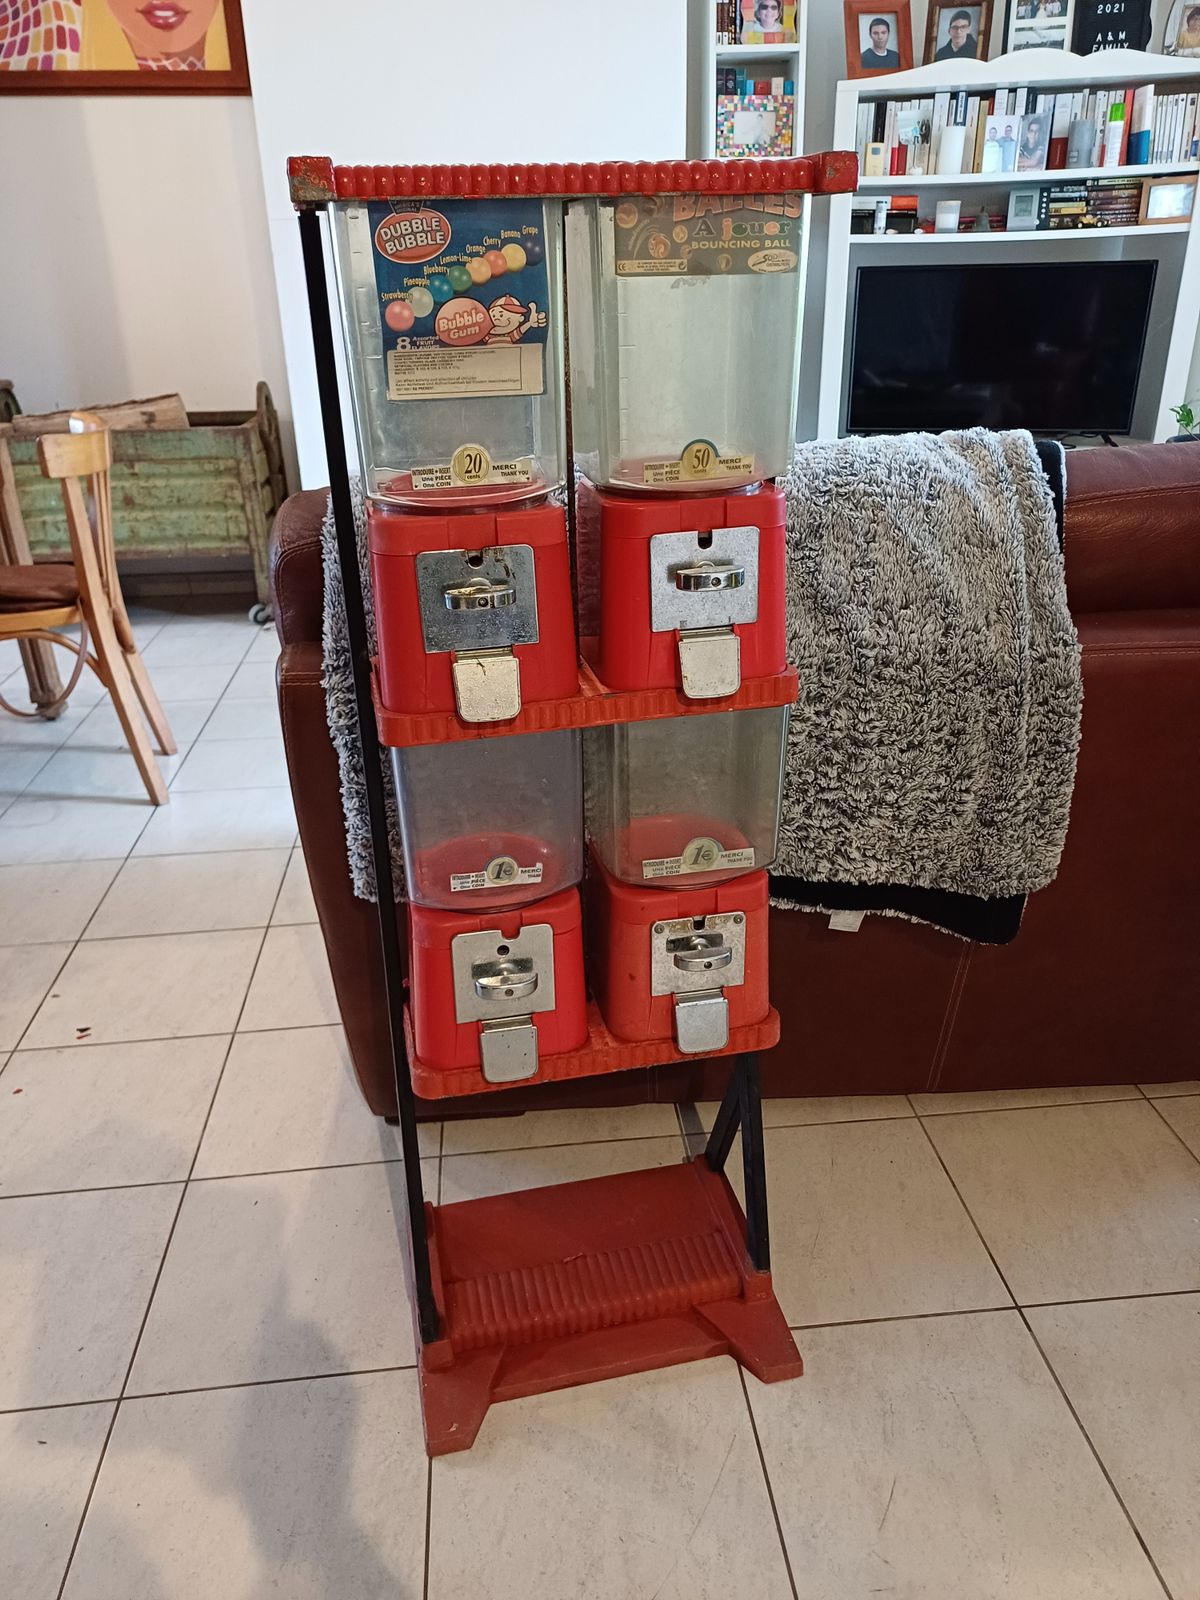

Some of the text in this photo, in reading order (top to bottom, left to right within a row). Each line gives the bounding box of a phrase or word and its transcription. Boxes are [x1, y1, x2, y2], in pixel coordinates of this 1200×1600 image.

[1097, 3, 1126, 14] 2021
[1096, 30, 1126, 42] A & M
[1092, 42, 1129, 52] FAMILY
[673, 194, 802, 222] BALLES
[380, 217, 441, 241] DUBBLE
[501, 230, 521, 239] Banana
[522, 225, 539, 235] Grape
[693, 218, 792, 241] A jouer
[385, 231, 446, 255] BUBBLE
[483, 236, 502, 247] Cherry
[691, 238, 792, 249] BOUNCING BALL
[466, 244, 486, 254] Orange
[440, 254, 473, 265] Lemon-Lime
[423, 264, 451, 276] Blueberry
[403, 277, 431, 287] Pineapple
[439, 308, 485, 332] Bubble
[449, 326, 480, 340] Gum
[396, 336, 411, 351] 8
[464, 452, 482, 474] 20
[692, 447, 710, 469] 50
